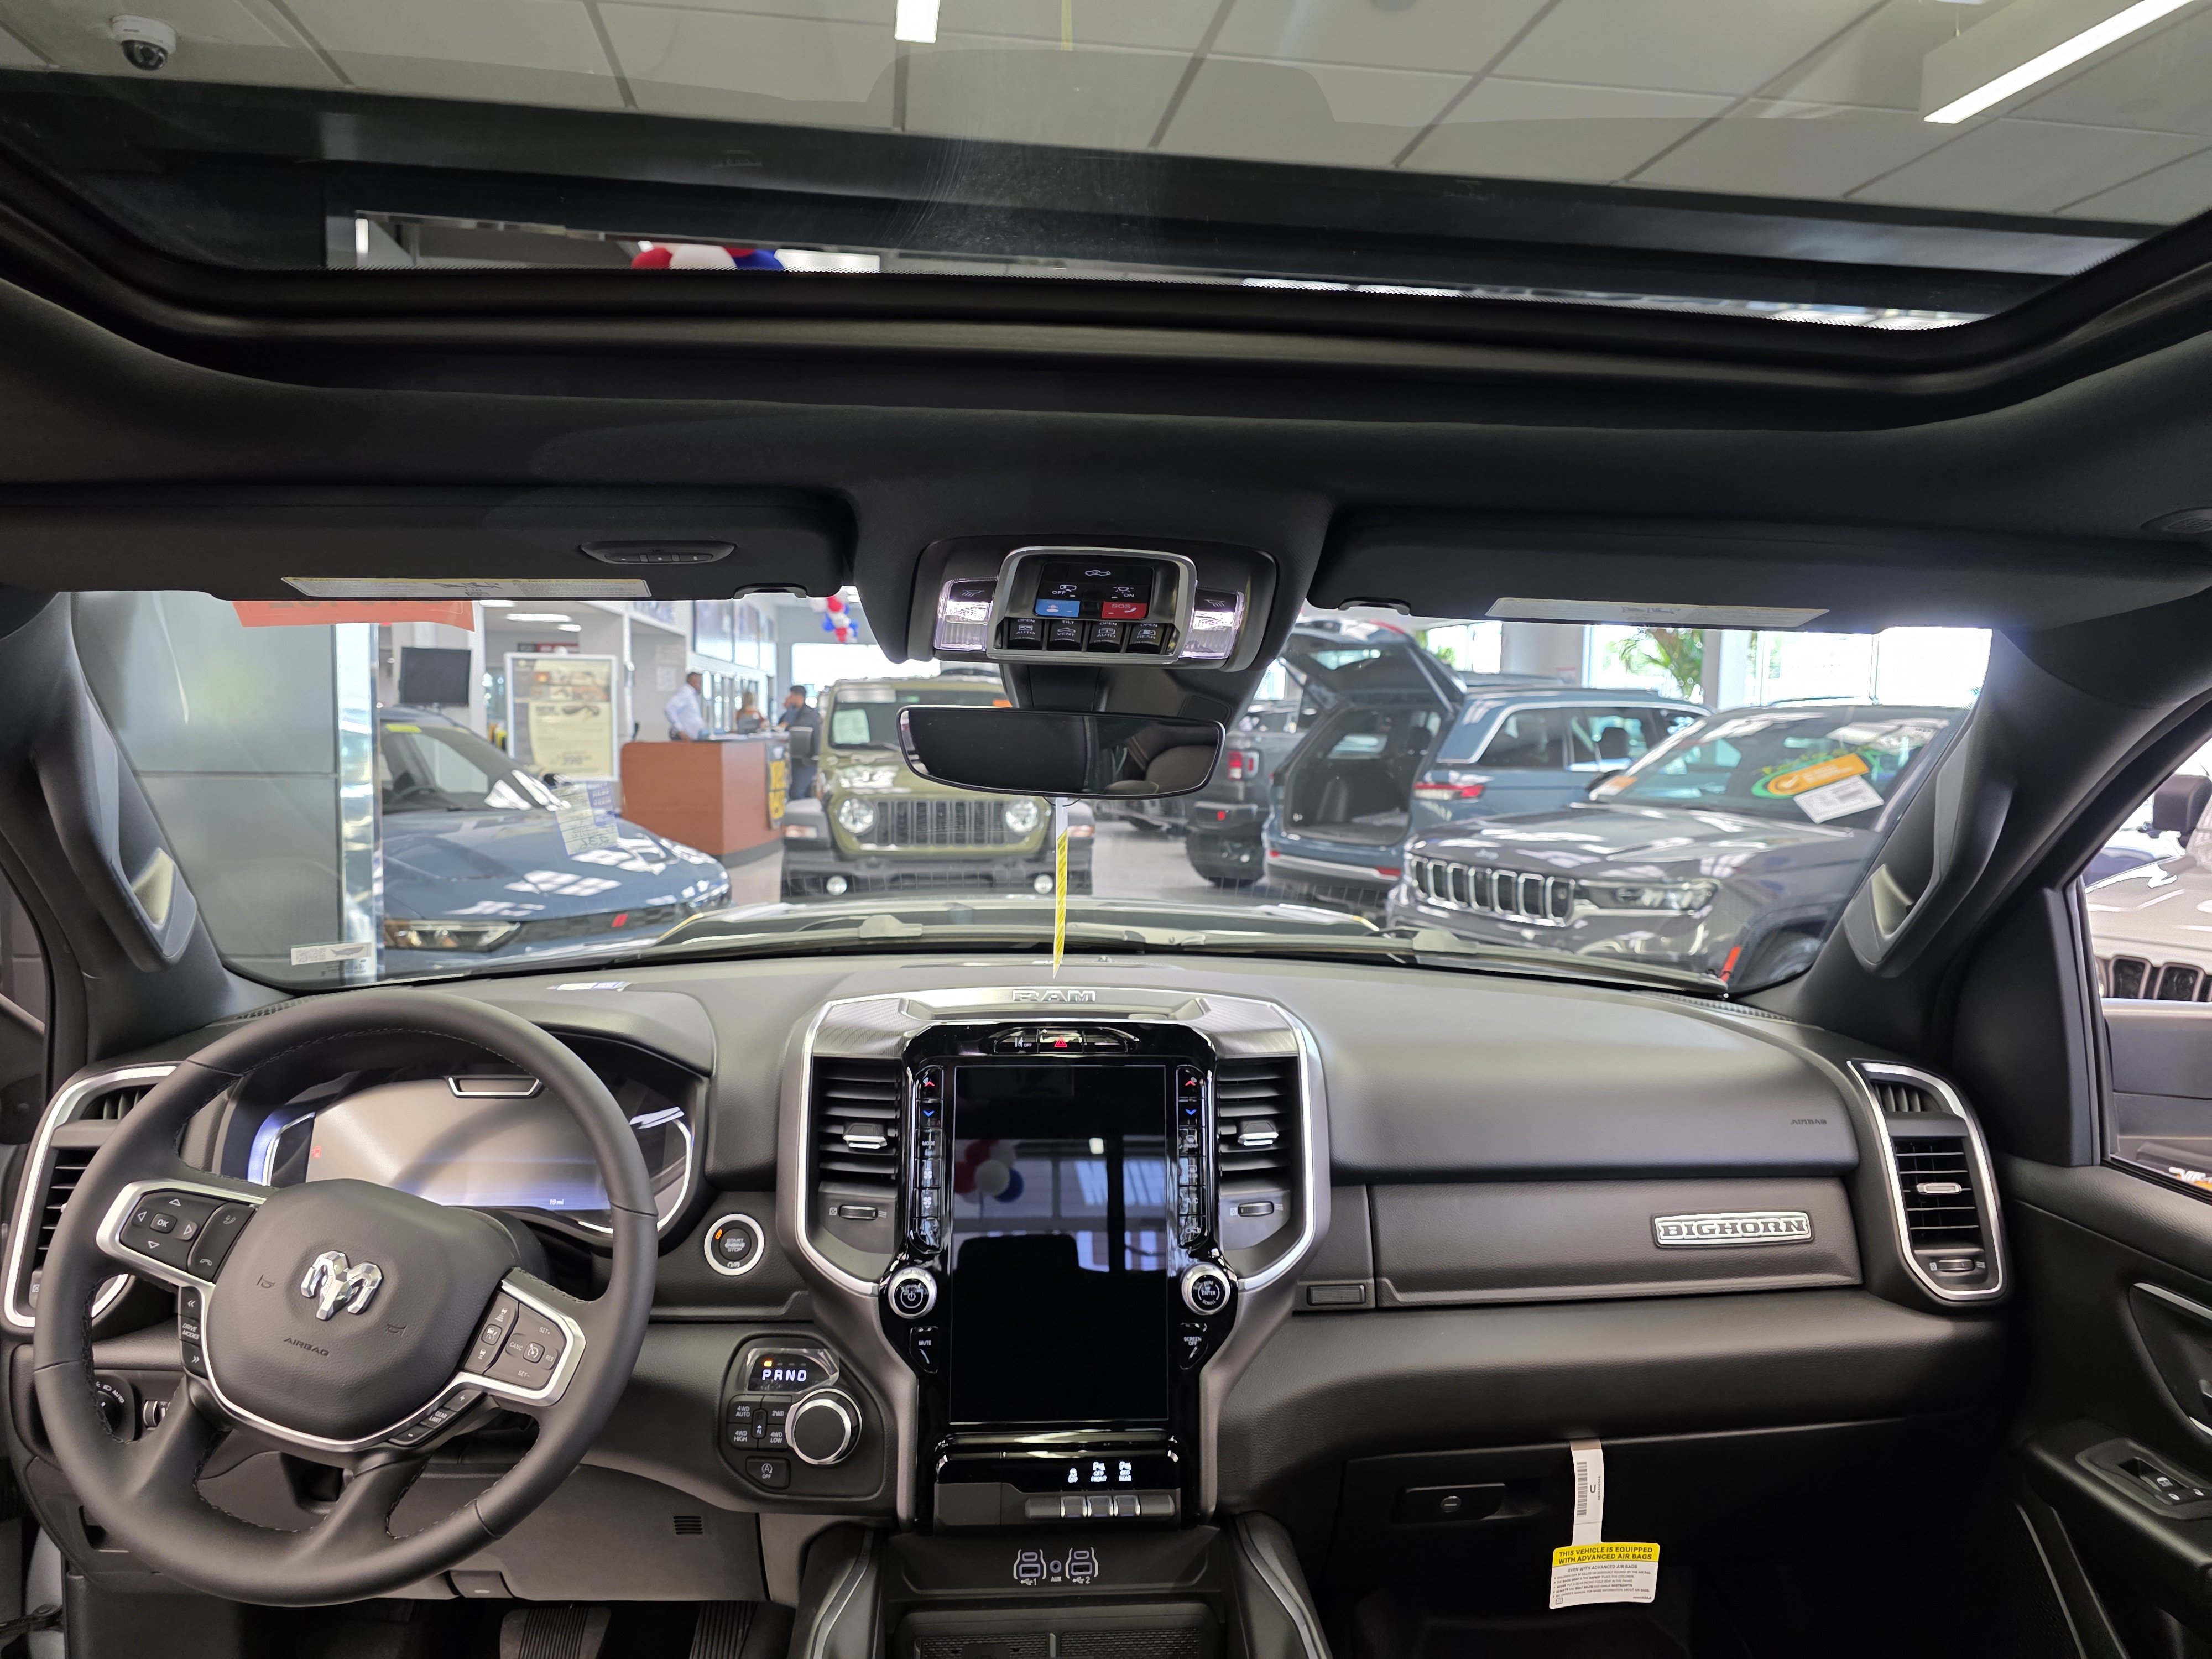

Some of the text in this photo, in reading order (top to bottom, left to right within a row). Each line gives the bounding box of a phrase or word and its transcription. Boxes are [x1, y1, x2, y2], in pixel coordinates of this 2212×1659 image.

[1013, 990, 1095, 1002] RAM
[157, 1219, 169, 1227] OK
[1660, 1219, 1807, 1238] BIGHORN
[182, 1323, 197, 1332] DRIVE
[182, 1329, 200, 1340] MODES
[284, 1337, 330, 1357] AIRBAG
[509, 1342, 523, 1352] CANC
[112, 1390, 125, 1404] AUTO
[435, 1411, 447, 1419] GEAR
[1590, 1484, 1596, 1493] U
